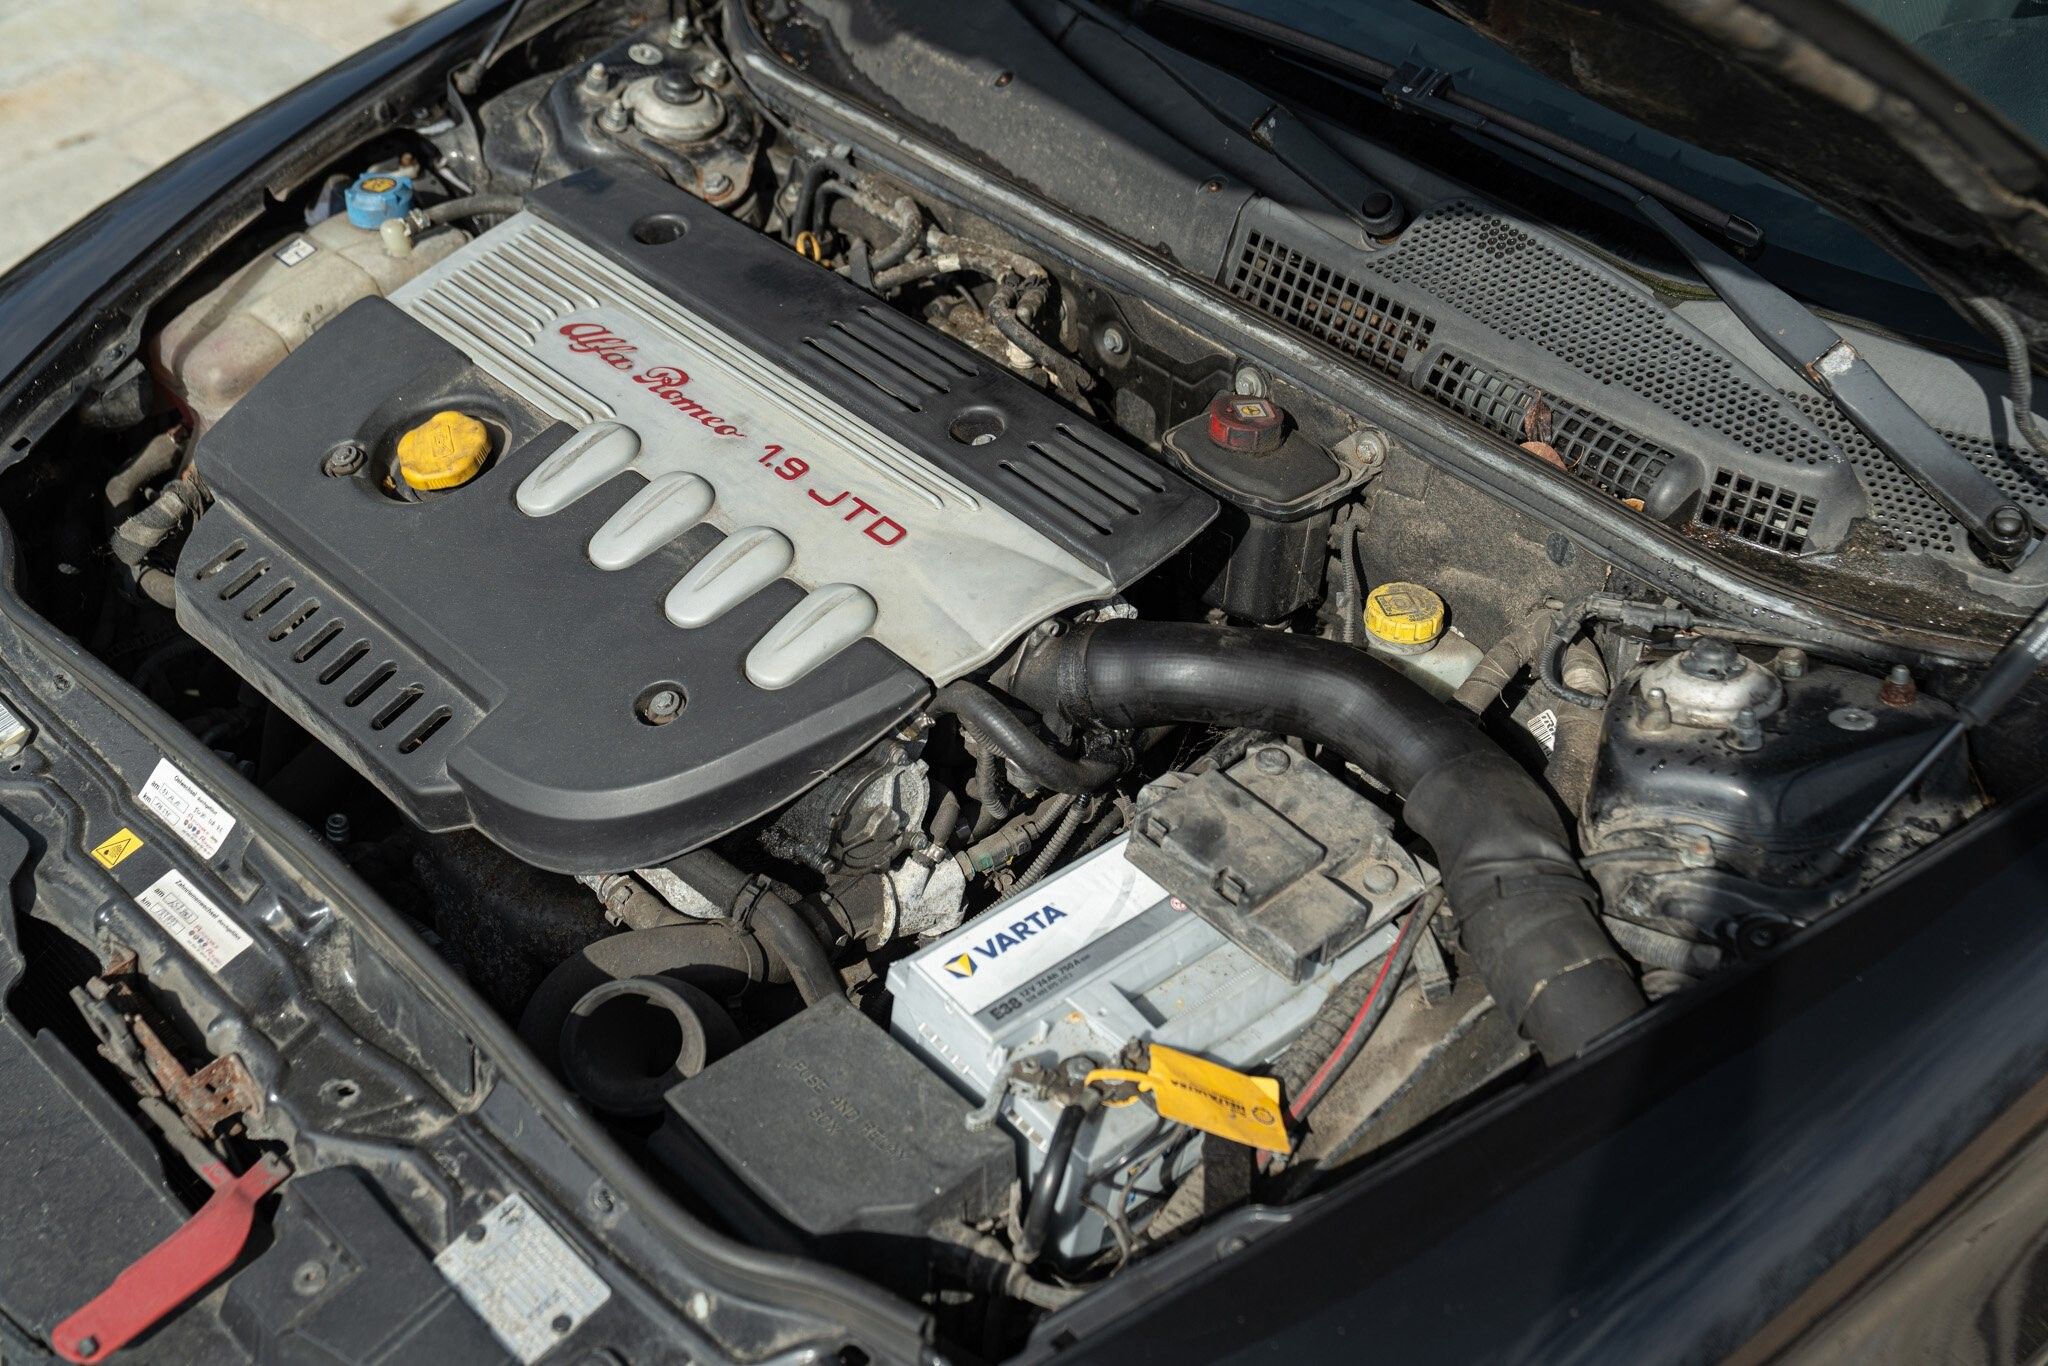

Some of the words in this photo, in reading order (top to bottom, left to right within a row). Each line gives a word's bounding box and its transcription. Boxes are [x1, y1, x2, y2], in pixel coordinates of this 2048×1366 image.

[559, 323, 638, 371] Alfa
[632, 367, 747, 438] Romeo
[758, 444, 810, 481] 1.9
[808, 488, 907, 546] JTD
[151, 781, 160, 790] am
[142, 793, 152, 802] km
[154, 887, 165, 897] am
[141, 896, 152, 907] km
[973, 905, 1068, 958] VARTA
[989, 997, 1022, 1020] E38
